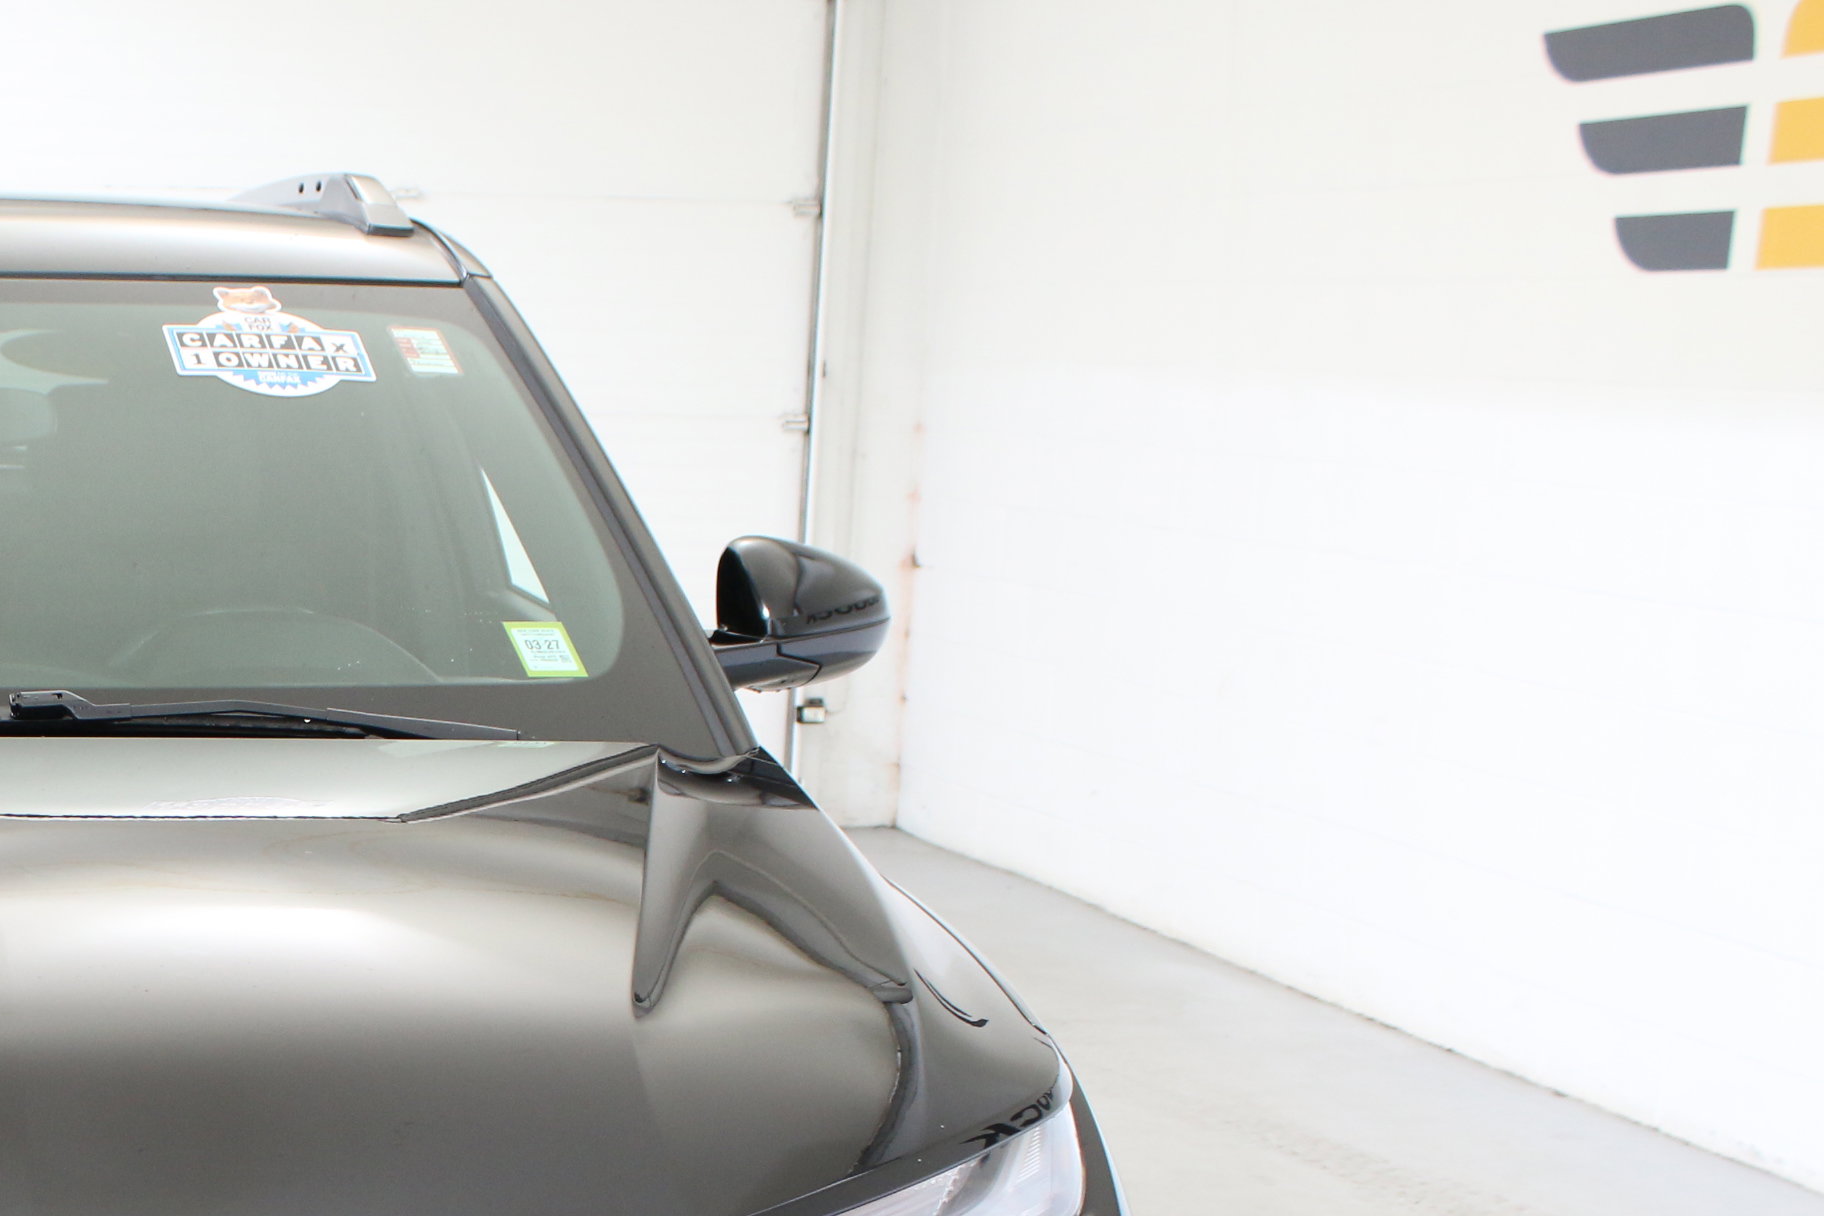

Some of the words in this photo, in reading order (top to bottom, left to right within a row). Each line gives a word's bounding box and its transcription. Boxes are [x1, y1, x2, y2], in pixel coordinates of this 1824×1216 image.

[181, 332, 346, 354] CARFAX
[192, 352, 208, 366] 1
[217, 352, 358, 373] OWNER
